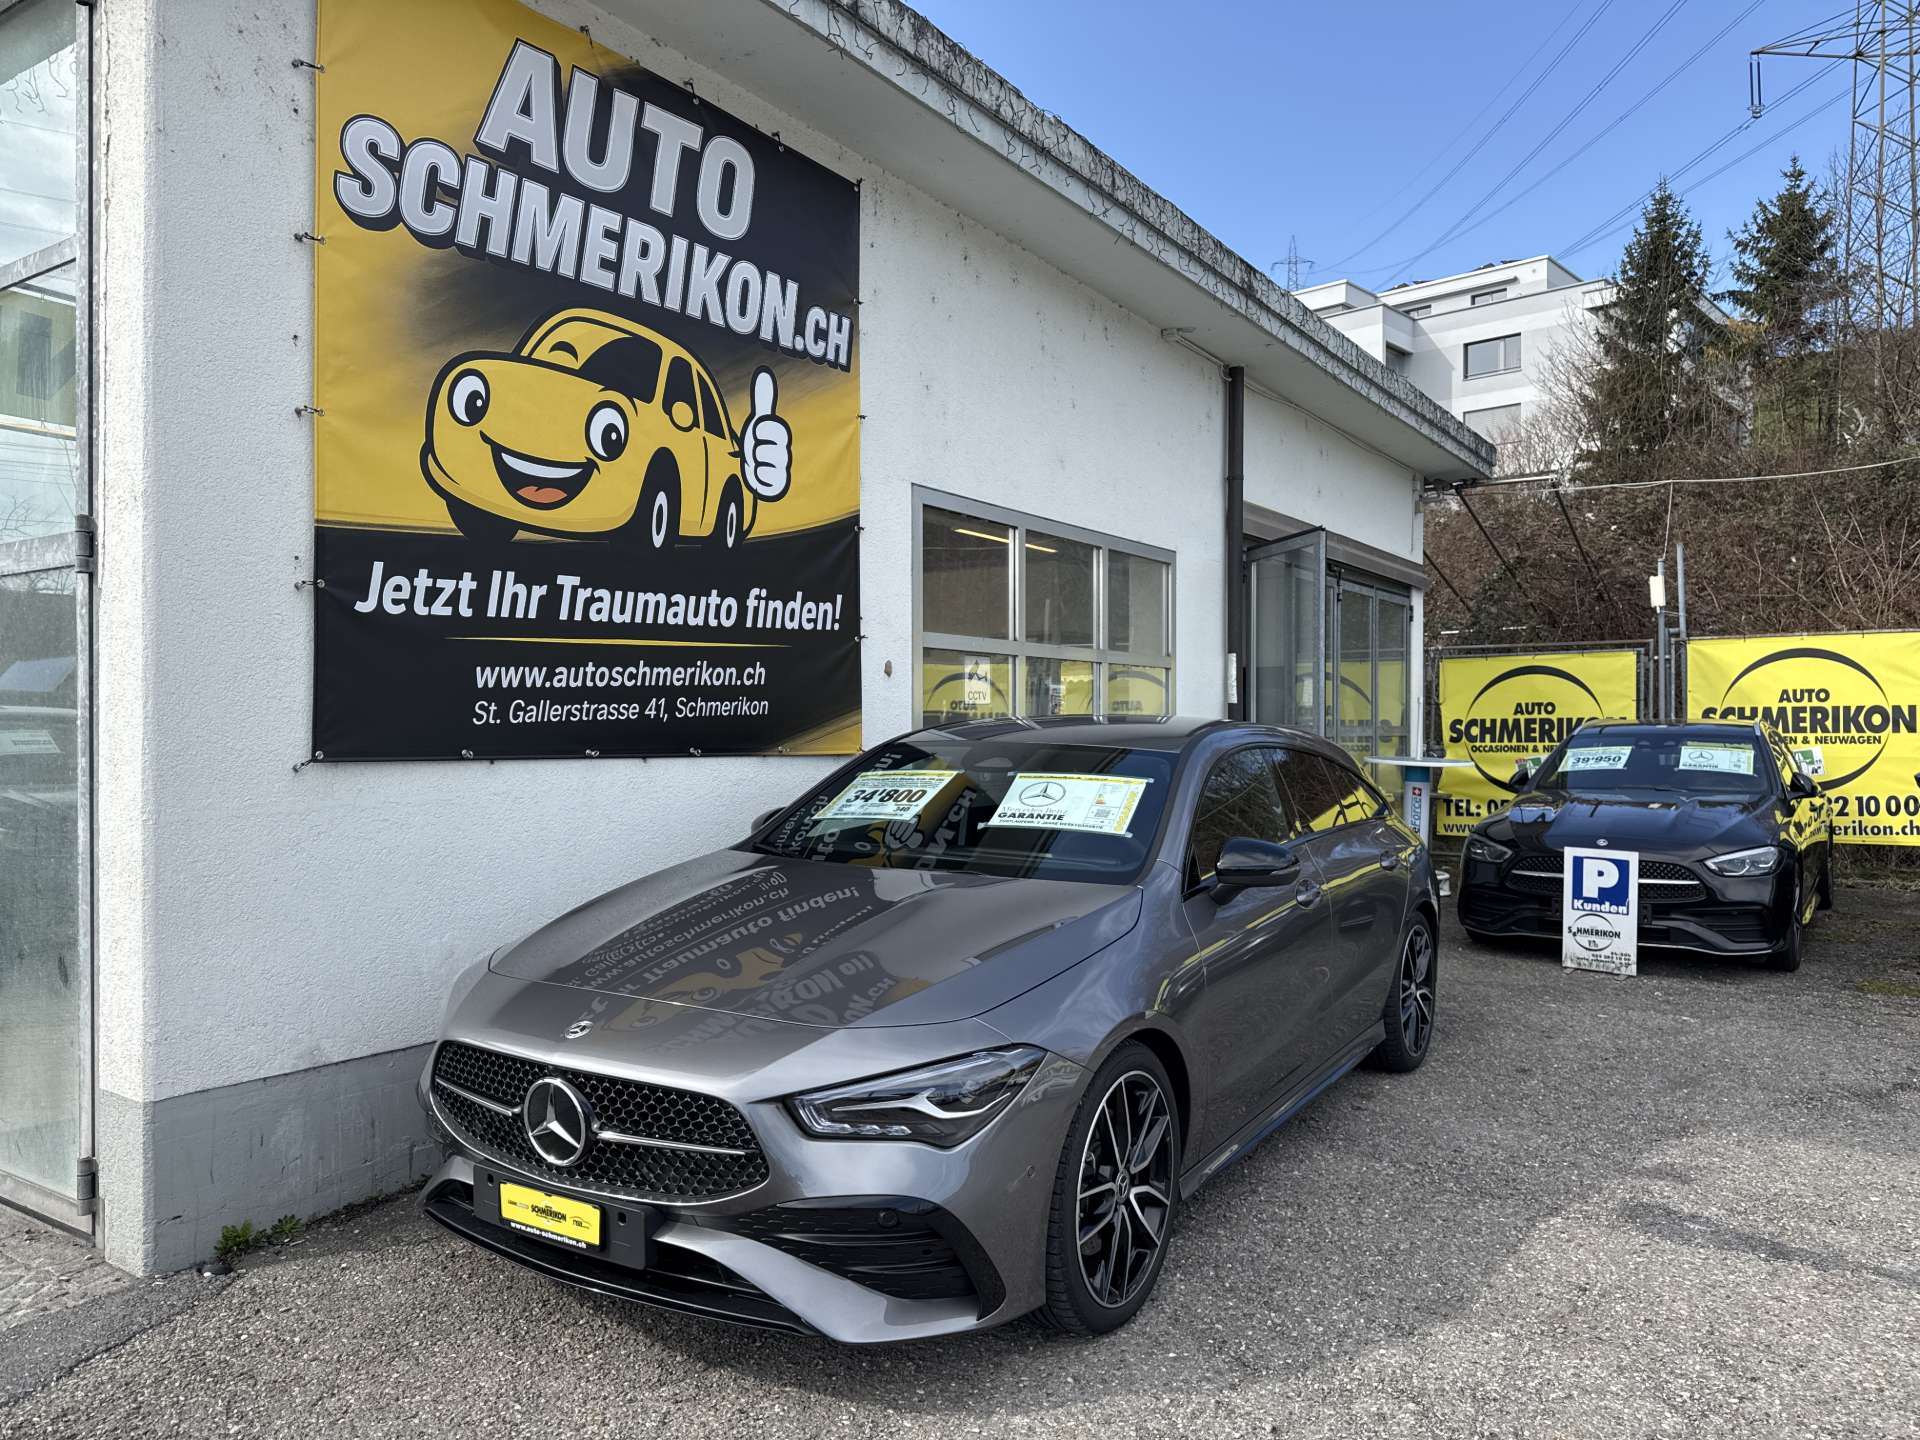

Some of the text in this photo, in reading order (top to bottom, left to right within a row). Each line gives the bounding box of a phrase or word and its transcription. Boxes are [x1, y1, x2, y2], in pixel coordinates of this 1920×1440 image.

[475, 39, 757, 241] AUTO
[335, 116, 852, 371] SCHMERIKON.CH
[353, 560, 843, 631] Jetzt Ihr Traumauto finden!
[475, 660, 766, 689] www.autoschmerikon.ch
[967, 690, 987, 701] CCTV
[1778, 688, 1831, 704] AUTO
[472, 696, 769, 725] St. Gallerstrasse 41, Schmerikon
[1513, 702, 1557, 716] AUTO
[1449, 716, 1627, 744] SCHMERIK
[1470, 744, 1529, 753] OCCASIONEN
[1814, 735, 1882, 745] NEUWAGEN
[1572, 754, 1622, 765] 39'950
[845, 788, 928, 804] 34'800
[1443, 799, 1481, 817] TEL:
[1855, 795, 1880, 817] 10
[997, 812, 1066, 821] GARANTIE
[1582, 858, 1620, 898] P
[1573, 899, 1628, 914] Kunden
[530, 1203, 567, 1222] SCHMERIKON
